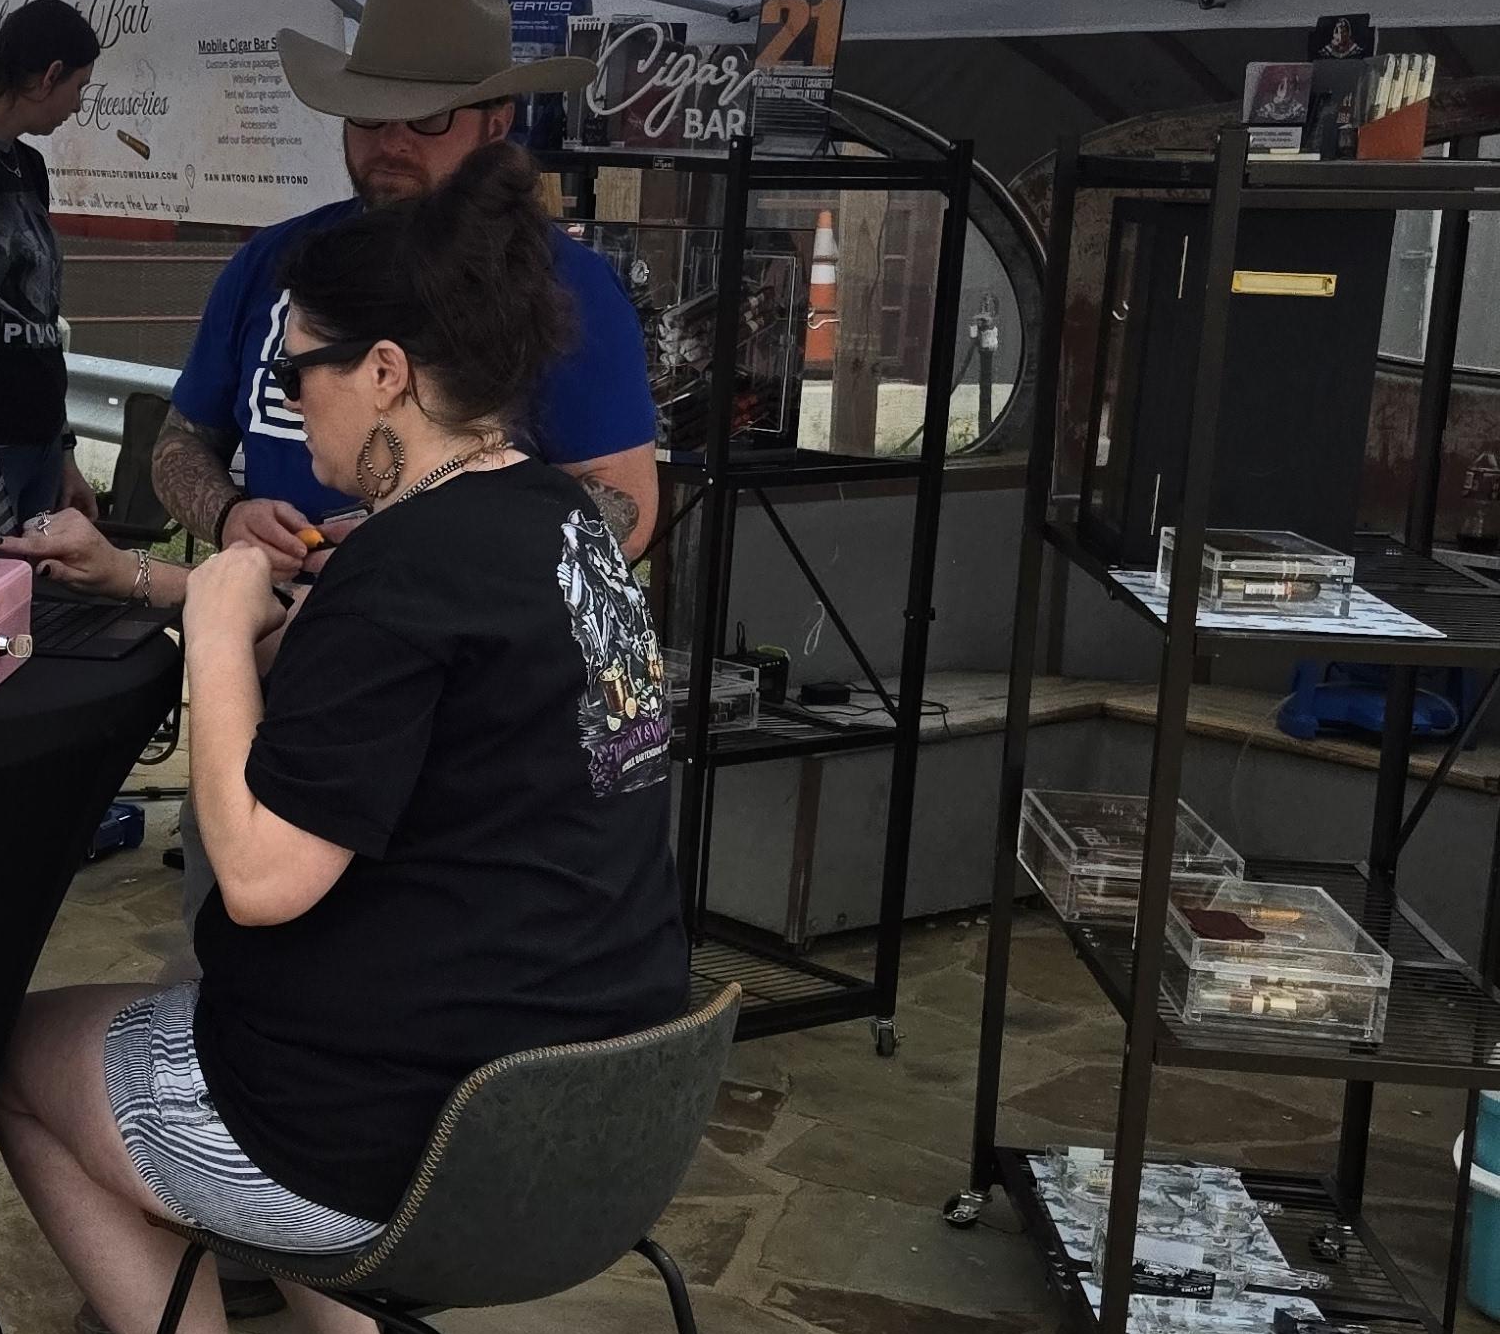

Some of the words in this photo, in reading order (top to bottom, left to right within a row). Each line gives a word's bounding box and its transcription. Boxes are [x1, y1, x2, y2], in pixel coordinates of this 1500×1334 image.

[198, 39, 228, 52] Mobile
[229, 38, 252, 55] Cigar
[253, 38, 270, 51] Bar
[586, 21, 762, 138] Cigar
[76, 83, 170, 130] Accessories
[682, 108, 747, 142] BAR
[204, 172, 220, 182] SAN
[221, 173, 256, 183] ANTONIO
[258, 174, 274, 184] AND
[276, 174, 308, 185] BEYOND
[102, 194, 128, 215] bring
[127, 195, 142, 211] the
[143, 195, 158, 211] bar
[160, 196, 171, 213] to
[4, 322, 58, 347] PIVO
